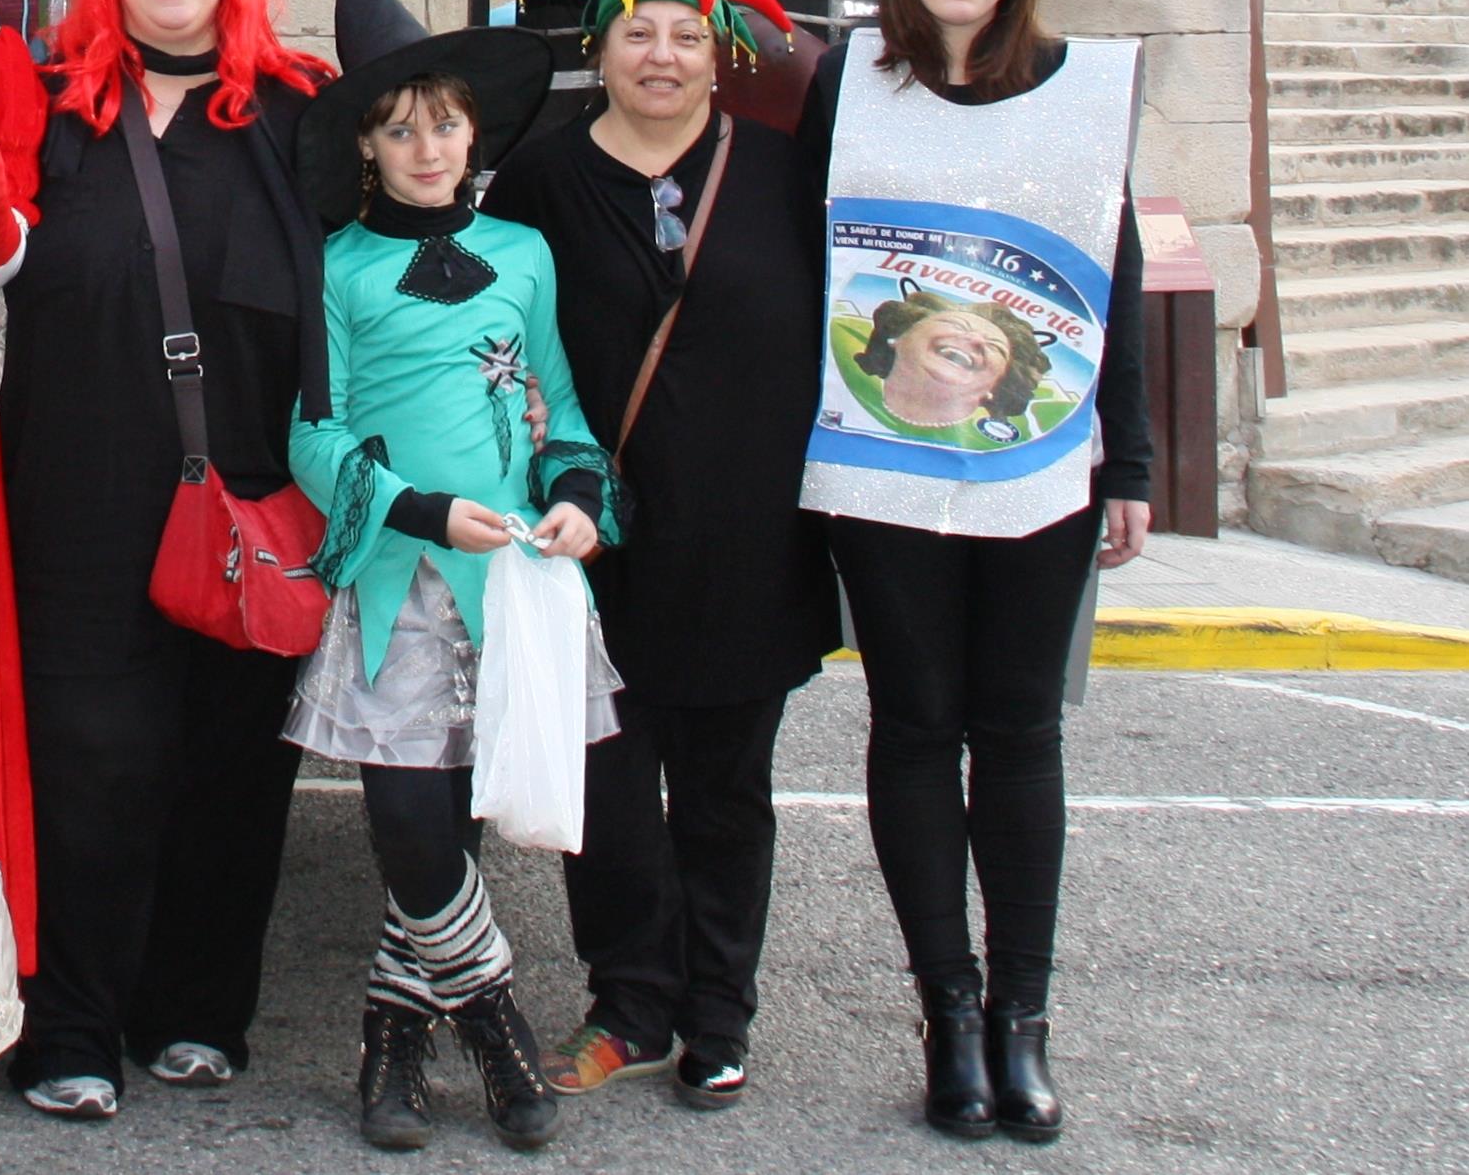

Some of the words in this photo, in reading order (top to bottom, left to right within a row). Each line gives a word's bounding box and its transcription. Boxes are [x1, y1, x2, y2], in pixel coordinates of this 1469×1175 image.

[834, 225, 847, 234] YA
[880, 227, 892, 238] DE
[895, 228, 925, 241] DONDE
[928, 232, 943, 244] ME
[834, 236, 859, 246] VIENE
[862, 238, 874, 247] MI
[874, 239, 914, 251] FELICIDAD
[991, 248, 1023, 272] 16
[877, 250, 916, 274] La
[920, 263, 989, 297] vaca
[992, 287, 1045, 319] que
[1046, 309, 1085, 339] ríe
